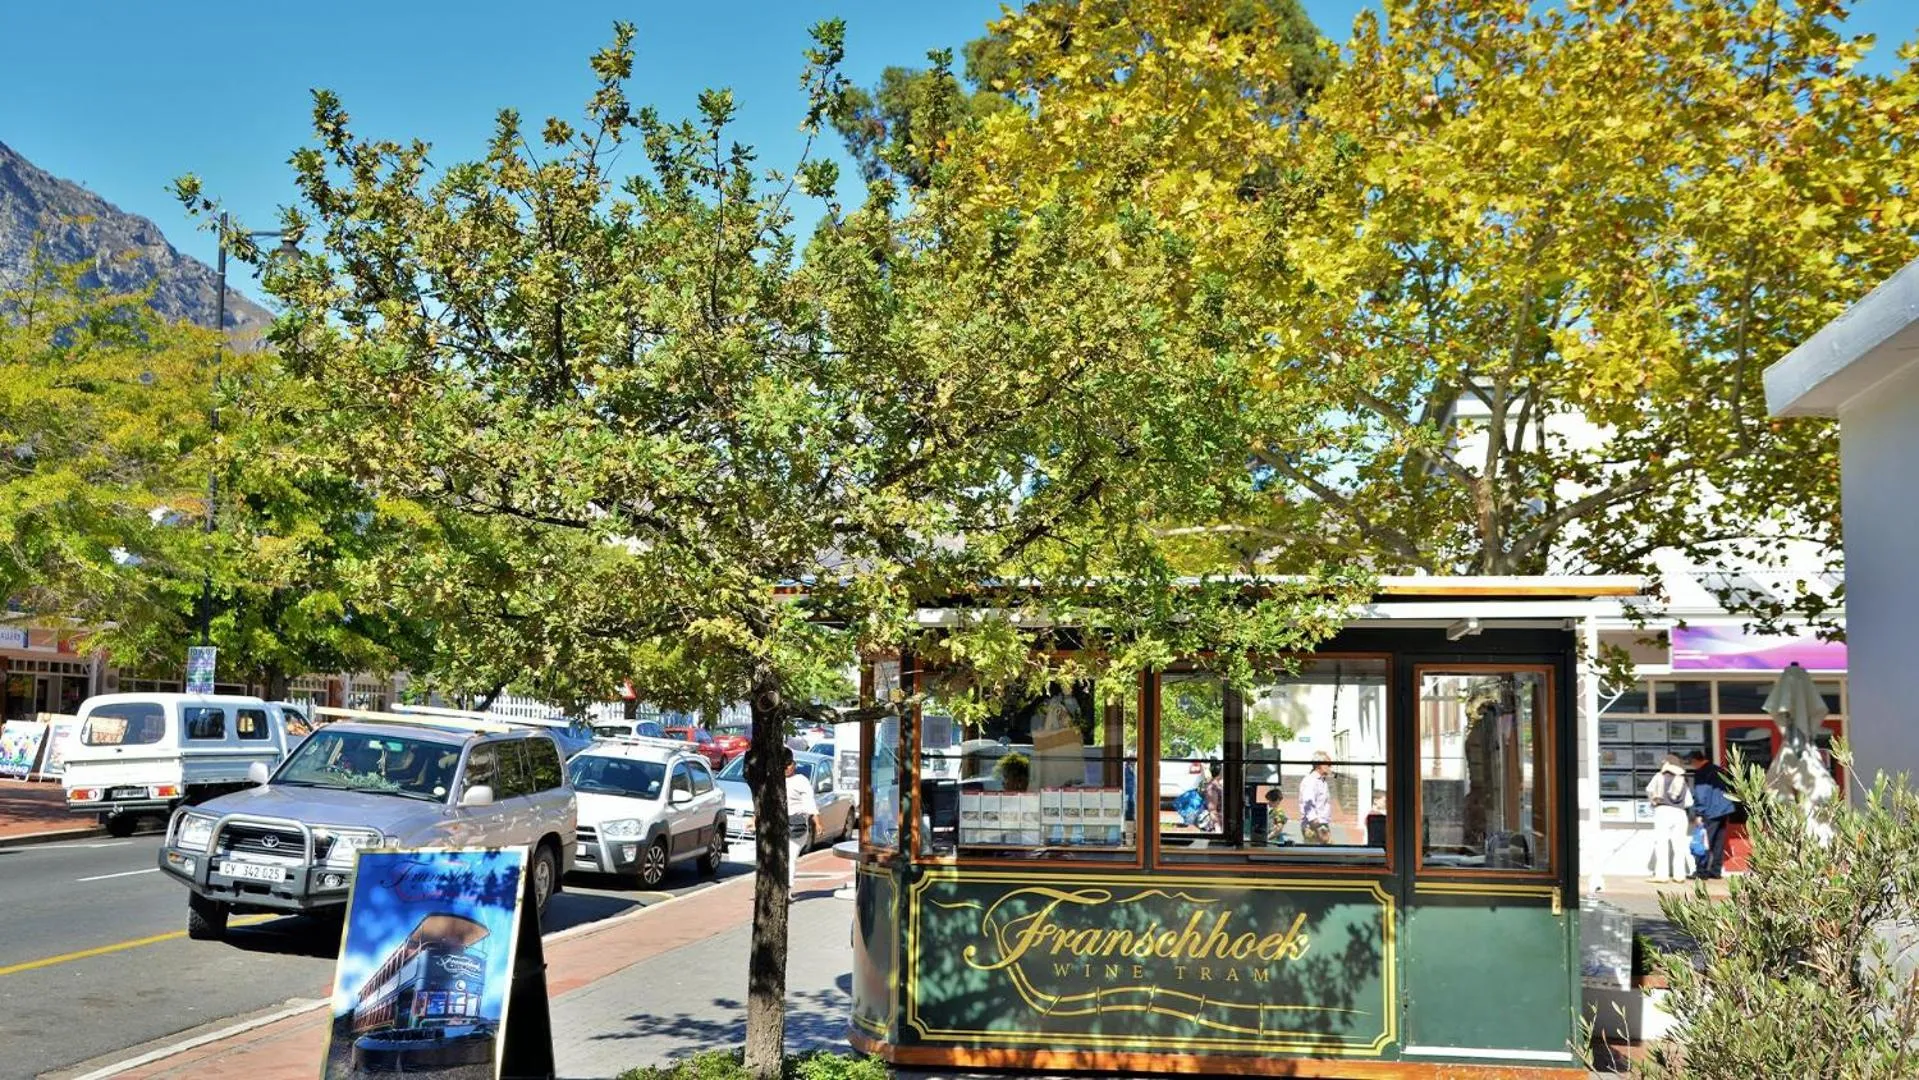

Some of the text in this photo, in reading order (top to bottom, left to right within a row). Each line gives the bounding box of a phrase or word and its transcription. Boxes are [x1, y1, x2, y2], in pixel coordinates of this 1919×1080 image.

[224, 863, 280, 880] CY 342 025
[963, 887, 1311, 970] Franschhoek
[1053, 962, 1271, 983] WINE TRAM
